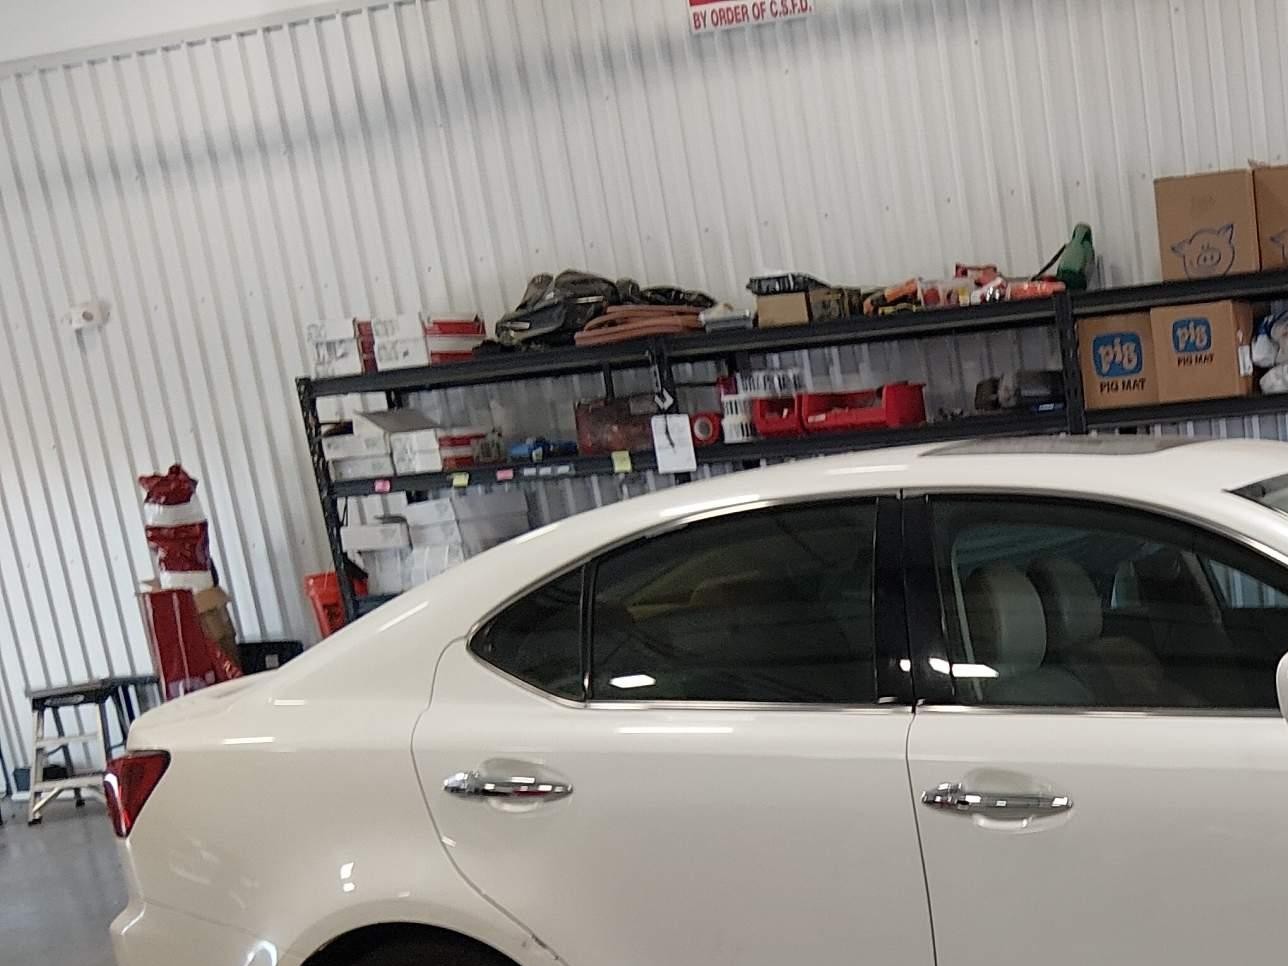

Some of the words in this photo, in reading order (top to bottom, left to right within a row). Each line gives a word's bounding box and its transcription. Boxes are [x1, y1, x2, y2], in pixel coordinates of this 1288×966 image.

[693, 10, 707, 30] BY
[711, 4, 750, 27] ORDER
[752, 1, 766, 20] OF
[1100, 380, 1119, 393] PIG
[1122, 378, 1147, 391] MAT
